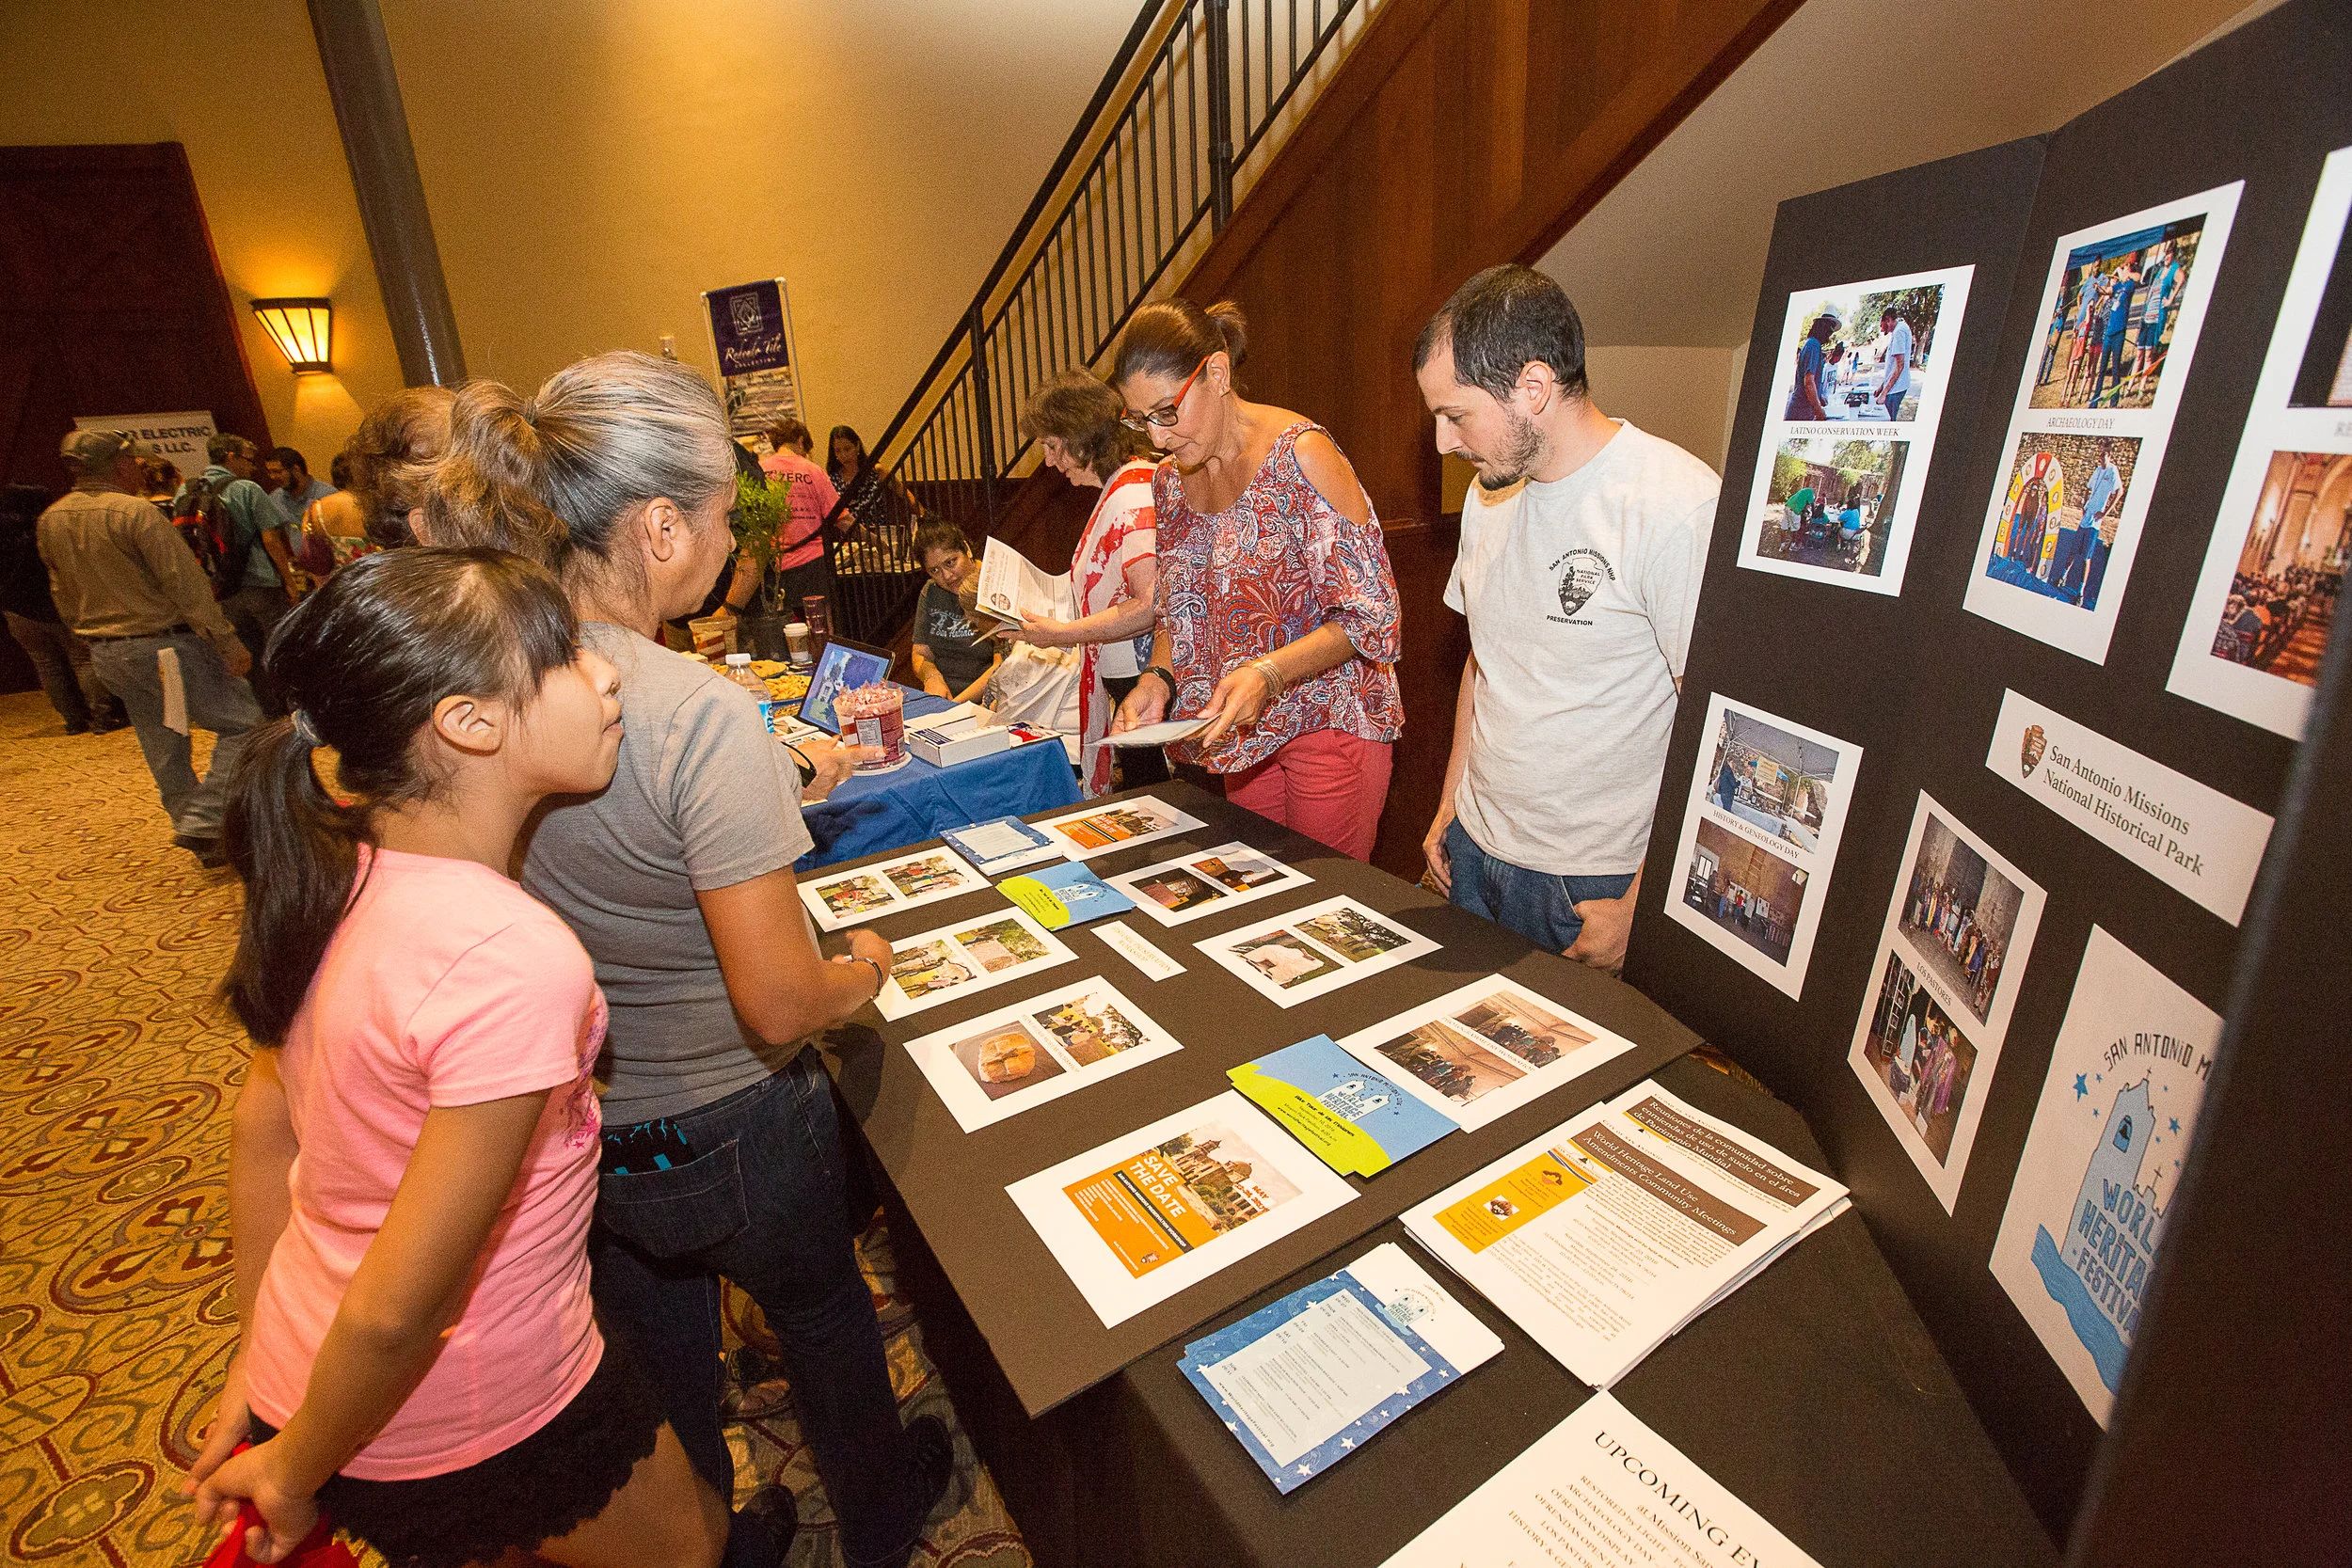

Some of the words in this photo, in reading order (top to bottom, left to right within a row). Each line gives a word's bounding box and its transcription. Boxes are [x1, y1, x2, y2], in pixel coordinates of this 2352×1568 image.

[142, 426, 211, 440] ELECTRIC
[1817, 427, 1874, 436] CONSERVATION
[1876, 428, 1900, 436] WEEK
[2047, 417, 2097, 428] ARCHAEOLOGY
[2098, 418, 2115, 429] DAY
[1549, 559, 1560, 571] SAN
[1562, 548, 1588, 560] ANTONIO
[1589, 549, 1610, 568] MISSIONS
[1607, 567, 1616, 581] NHP
[1546, 615, 1593, 626] PRESERVATION
[2049, 745, 2071, 770] San
[2071, 758, 2122, 797] Antonio
[2123, 785, 2190, 835] Missions
[1713, 810, 1738, 828] HISTORY
[1744, 827, 1783, 851] GENEOLOGY
[1784, 846, 1799, 858] DAY
[2043, 768, 2093, 810] National
[2093, 798, 2164, 852] Historical
[2164, 839, 2205, 877] Park
[1917, 962, 1926, 977] LOS
[1926, 973, 1951, 1006] PASTORES
[2104, 1036, 2128, 1072] SAN
[1321, 1099, 1349, 1119] FESTIVAL
[1325, 1092, 1363, 1118] HERITAGE
[1338, 1091, 1365, 1108] WORLD
[1592, 1130, 1618, 1151] World
[1618, 1148, 1654, 1175] Heritage
[1654, 1172, 1680, 1189] Land
[1681, 1188, 1698, 1202] Use
[1634, 1111, 1645, 1121] de
[1646, 1119, 1692, 1150] Patrimonio
[1692, 1144, 1731, 1170] Mundial
[1641, 1107, 1685, 1136] enmiendas
[1686, 1132, 1698, 1142] de
[1699, 1139, 1715, 1151] uso
[1716, 1148, 1728, 1158] de
[1729, 1154, 1753, 1173] suelo
[1754, 1171, 1767, 1180] en
[1768, 1176, 1779, 1186] el
[1779, 1182, 1800, 1198] área
[1649, 1101, 1692, 1129] Reuniones
[1694, 1126, 1704, 1134] de
[1705, 1132, 1714, 1141] la
[1715, 1137, 1766, 1170] comunidad
[1768, 1166, 1794, 1185] sobre
[1129, 1161, 1157, 1186] THE
[1149, 1185, 1187, 1218] DATE
[1143, 1155, 1178, 1187] SAVE
[1252, 1185, 1270, 1199] MAY
[1583, 1136, 1637, 1175] Amendments
[1638, 1173, 1692, 1209] Community
[1692, 1207, 1737, 1235] Meetings
[1116, 1173, 1126, 1181] SAN
[1122, 1180, 1137, 1193] ANTONIO
[1145, 1204, 1171, 1229] PRESERVATION
[1165, 1227, 1188, 1248] WORKSHOP
[2103, 1178, 2159, 1263] WORL
[2078, 1199, 2147, 1301] HERITA
[2077, 1251, 2138, 1337] FESTIVA
[1580, 1475, 1627, 1519] RESTORED
[1626, 1515, 1636, 1526] by
[1636, 1524, 1668, 1554] LIGHT
[1595, 1429, 1729, 1547] UPCOMING
[1508, 1510, 1548, 1549] HISTORY
[1546, 1547, 1554, 1556] &
[1535, 1494, 1581, 1539] OFRENDAS
[1580, 1536, 1608, 1563] OPEN
[1540, 1520, 1560, 1538] LOS
[1558, 1537, 1597, 1568] PASTOR
[1551, 1488, 1599, 1534] OFRENDAS
[1596, 1530, 1636, 1567] DISPLAY
[1566, 1484, 1634, 1544] ARCHAEOLOGY
[1634, 1540, 1655, 1563] DAY
[1637, 1504, 1649, 1516] at
[1648, 1513, 1692, 1553] Mission
